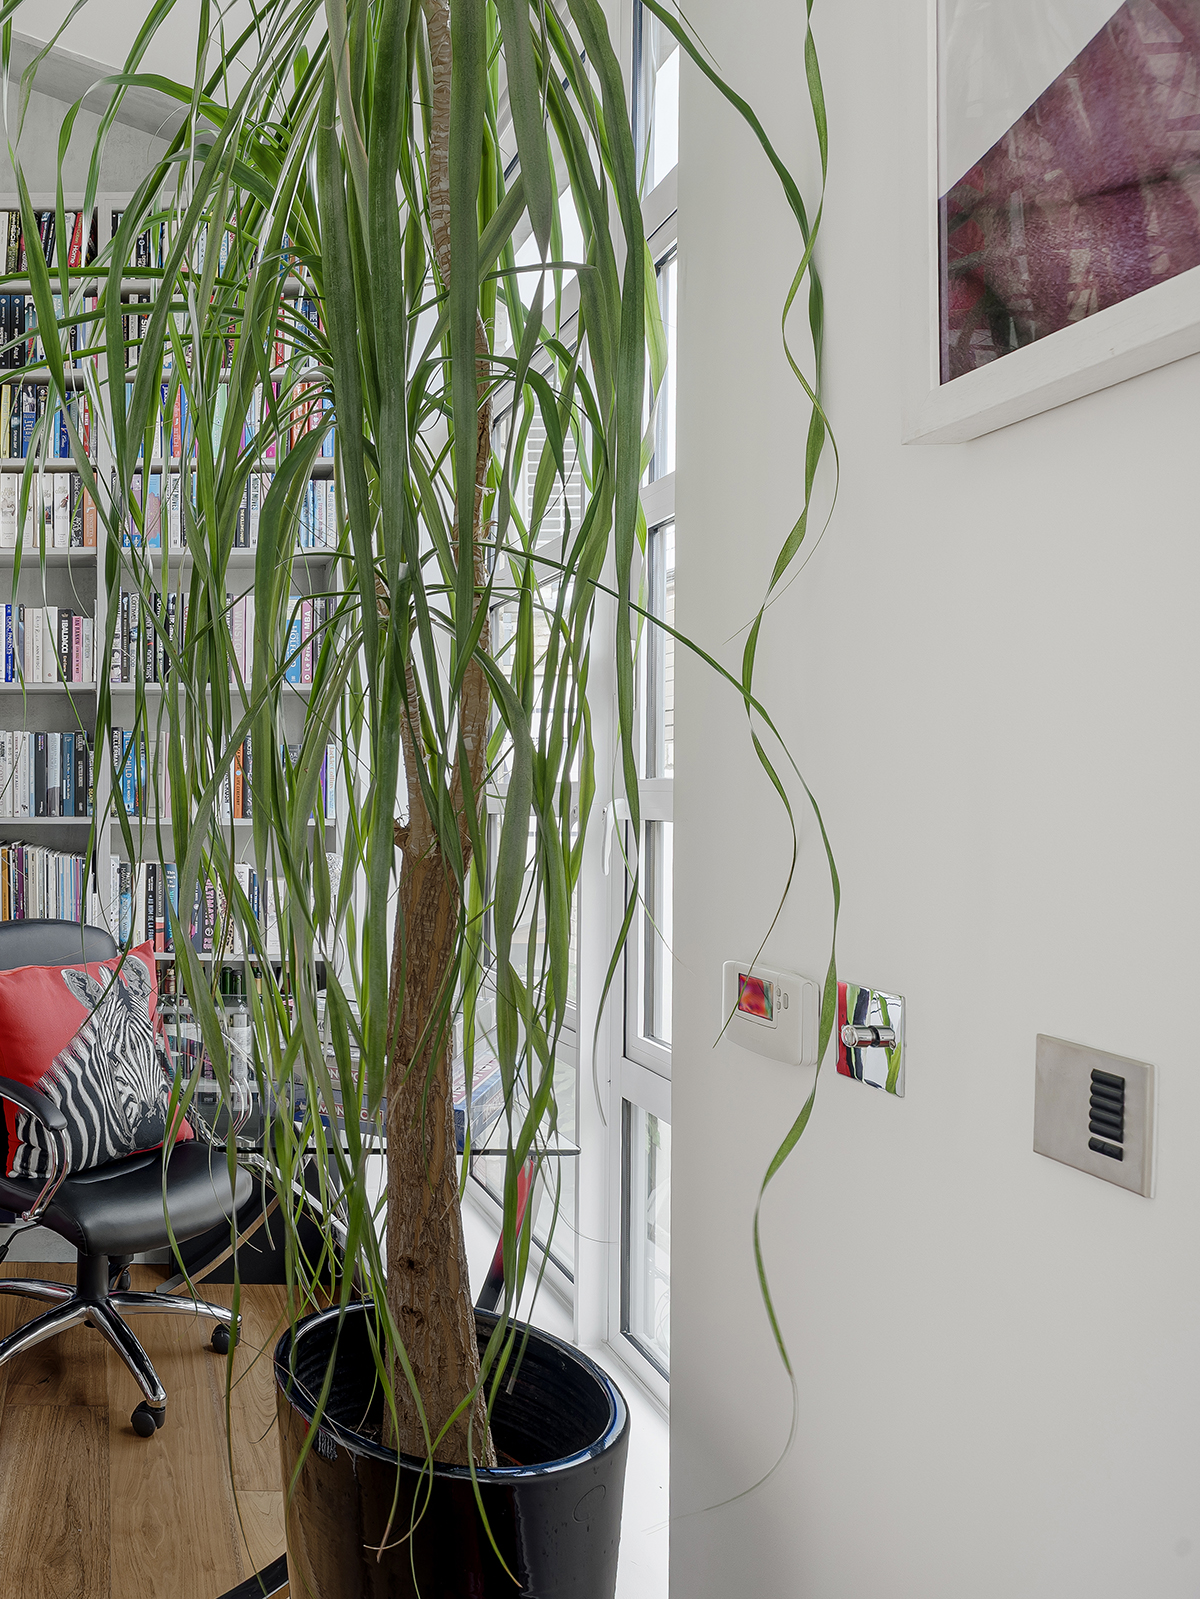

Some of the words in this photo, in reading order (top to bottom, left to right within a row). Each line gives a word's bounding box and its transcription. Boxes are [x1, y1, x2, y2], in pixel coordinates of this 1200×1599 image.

[70, 244, 80, 264] Home
[61, 622, 69, 654] BALDACCI
[234, 610, 243, 658] WINSTON
[289, 625, 297, 668] HOLFOD
